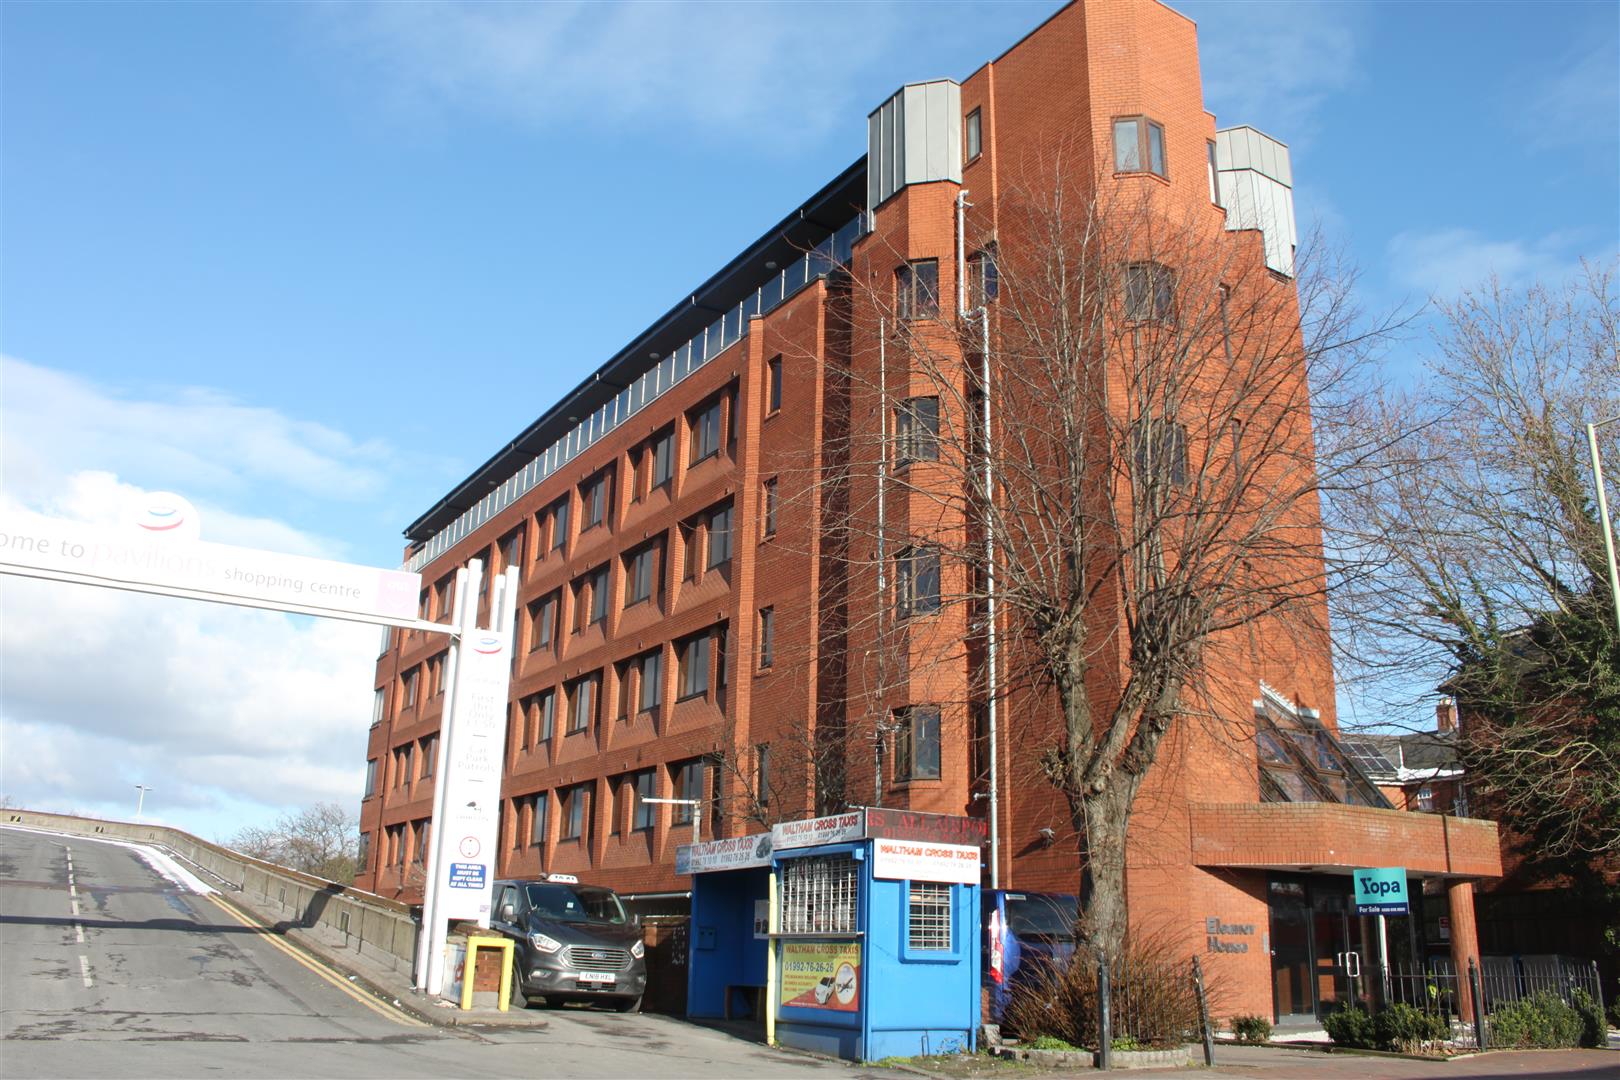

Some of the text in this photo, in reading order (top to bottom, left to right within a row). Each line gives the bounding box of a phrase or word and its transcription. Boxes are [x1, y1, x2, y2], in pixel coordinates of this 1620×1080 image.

[61, 539, 85, 558] to
[92, 542, 216, 577] pavilions
[224, 567, 303, 593] shopping
[310, 580, 361, 599] centre
[783, 815, 858, 835] WALTHAM CROSS TAXIS
[692, 837, 753, 857] WALTHAM CROSS TAXIS
[880, 844, 978, 861] WALTHAM CROSS TAXIS
[1360, 877, 1401, 897] Yopa
[786, 945, 815, 953] WALTHAM
[816, 945, 838, 954] CROSS
[1207, 936, 1248, 953] House
[785, 961, 834, 972] 01992-76-26-26
